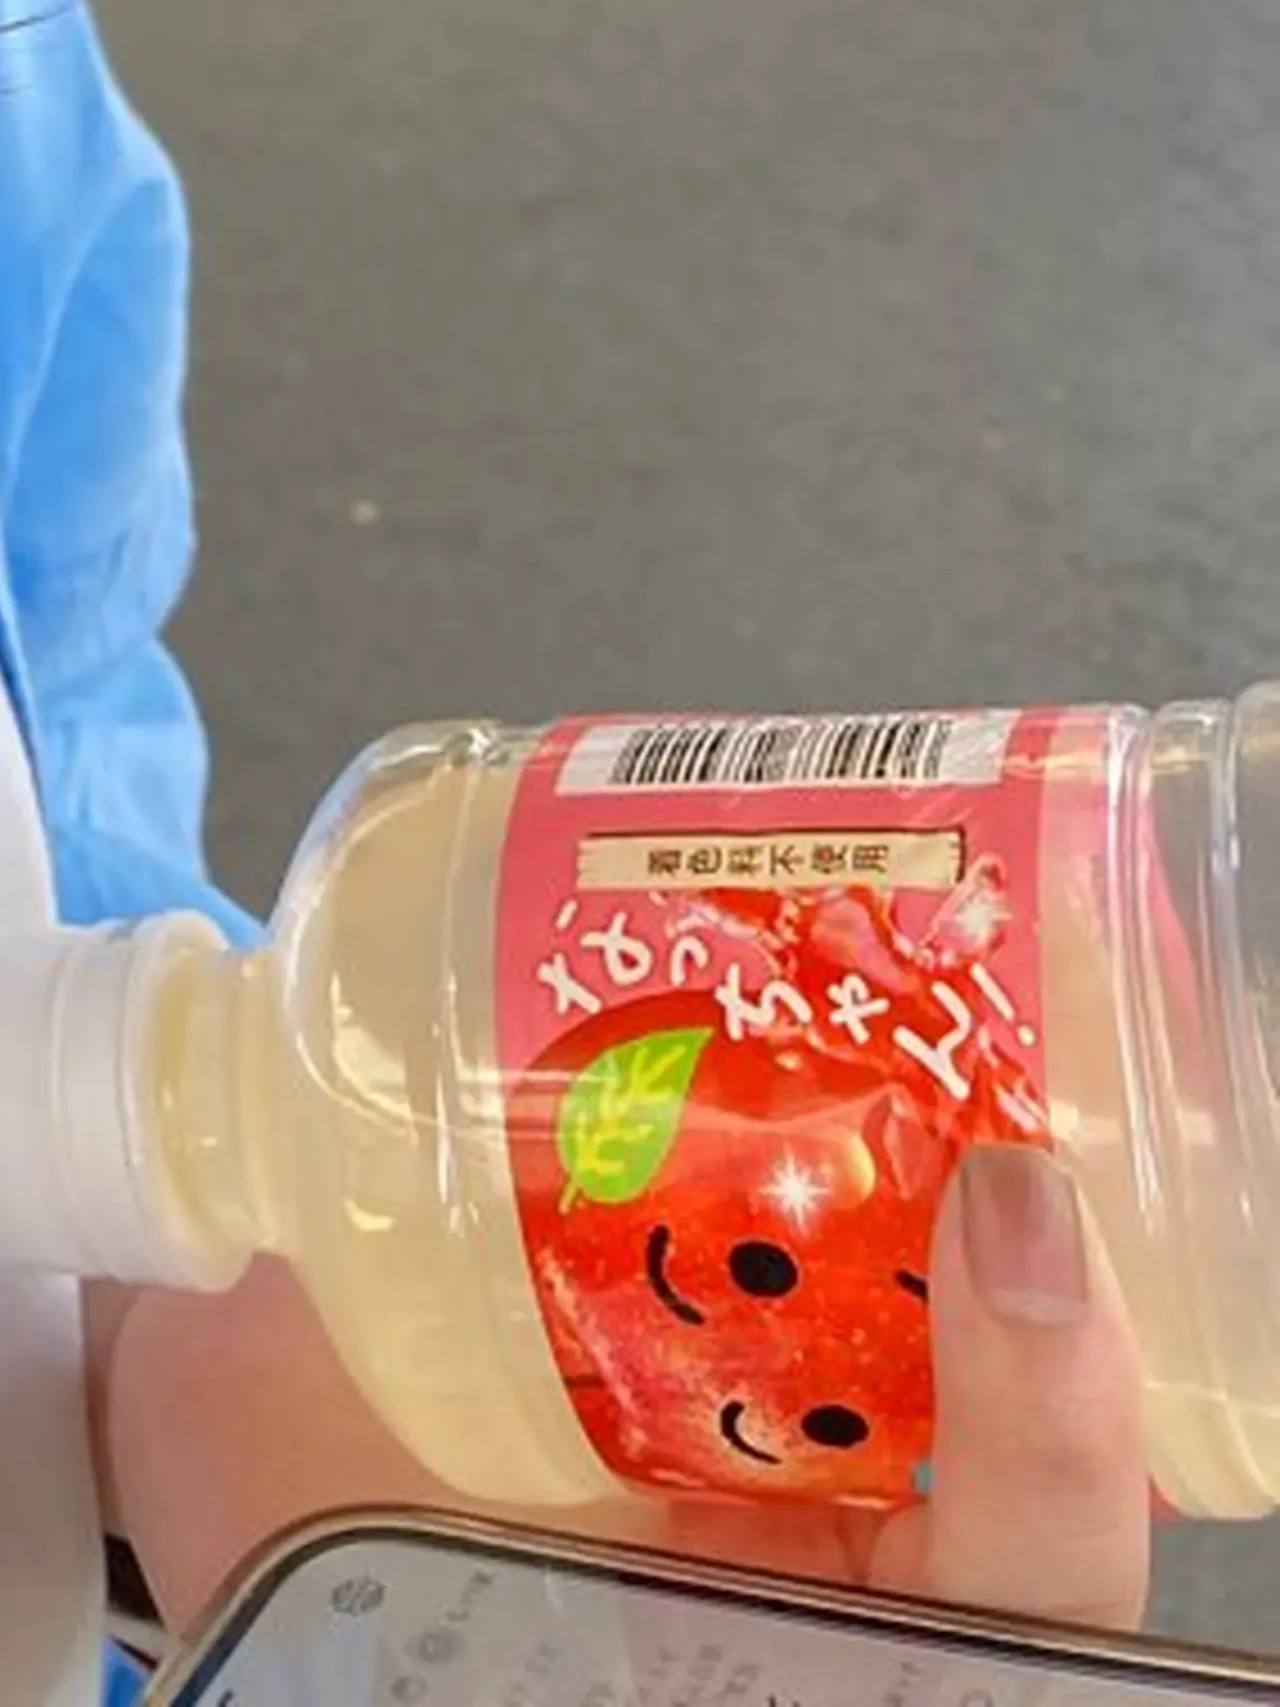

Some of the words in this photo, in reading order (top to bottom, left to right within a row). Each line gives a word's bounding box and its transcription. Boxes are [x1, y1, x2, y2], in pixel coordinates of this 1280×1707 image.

[647, 843, 889, 876] 着色料不使用
